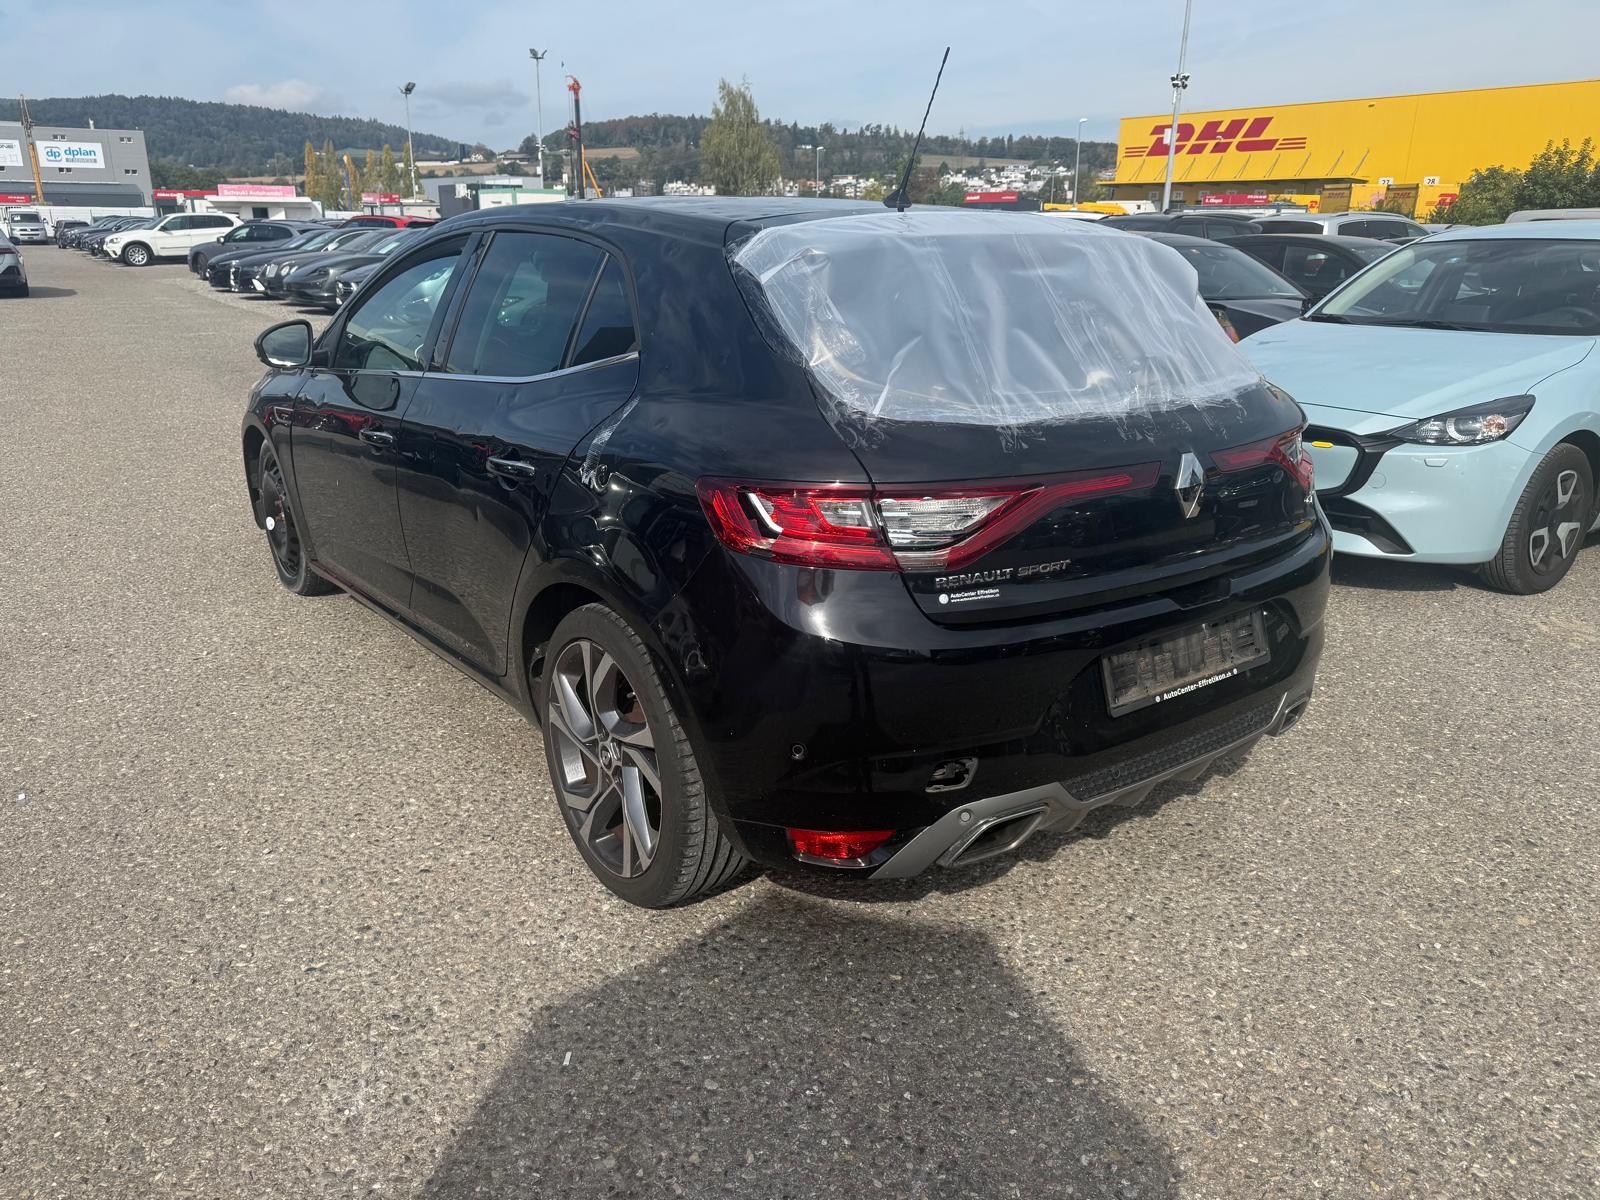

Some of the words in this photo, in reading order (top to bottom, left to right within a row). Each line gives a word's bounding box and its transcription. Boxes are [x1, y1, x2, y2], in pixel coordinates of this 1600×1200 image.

[1145, 116, 1279, 157] DHL
[46, 149, 61, 159] dp
[64, 147, 96, 157] dplan
[935, 567, 1013, 589] RENAULT
[1017, 559, 1072, 577] SPORT
[950, 591, 976, 599] AutoCenter
